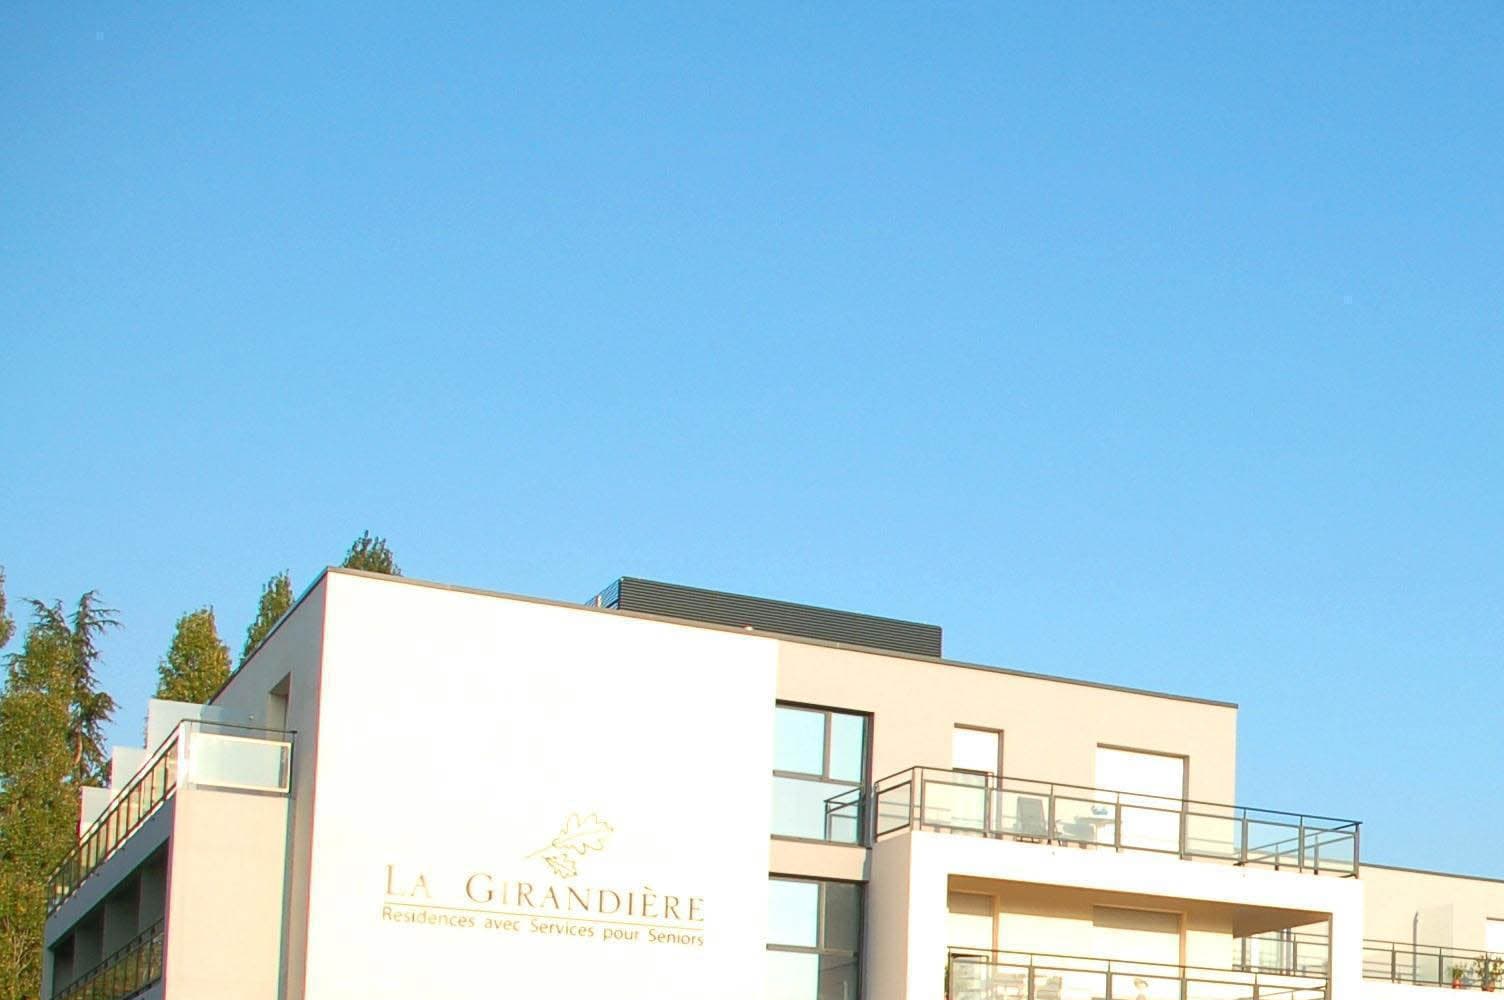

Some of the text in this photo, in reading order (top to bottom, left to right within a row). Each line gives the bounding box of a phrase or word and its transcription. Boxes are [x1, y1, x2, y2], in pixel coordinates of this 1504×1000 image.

[384, 863, 705, 922] LA GIRANDIÈRE
[484, 917, 520, 932] avec
[529, 919, 594, 938] Services
[603, 926, 639, 943] pour
[648, 928, 705, 947] Seniors
